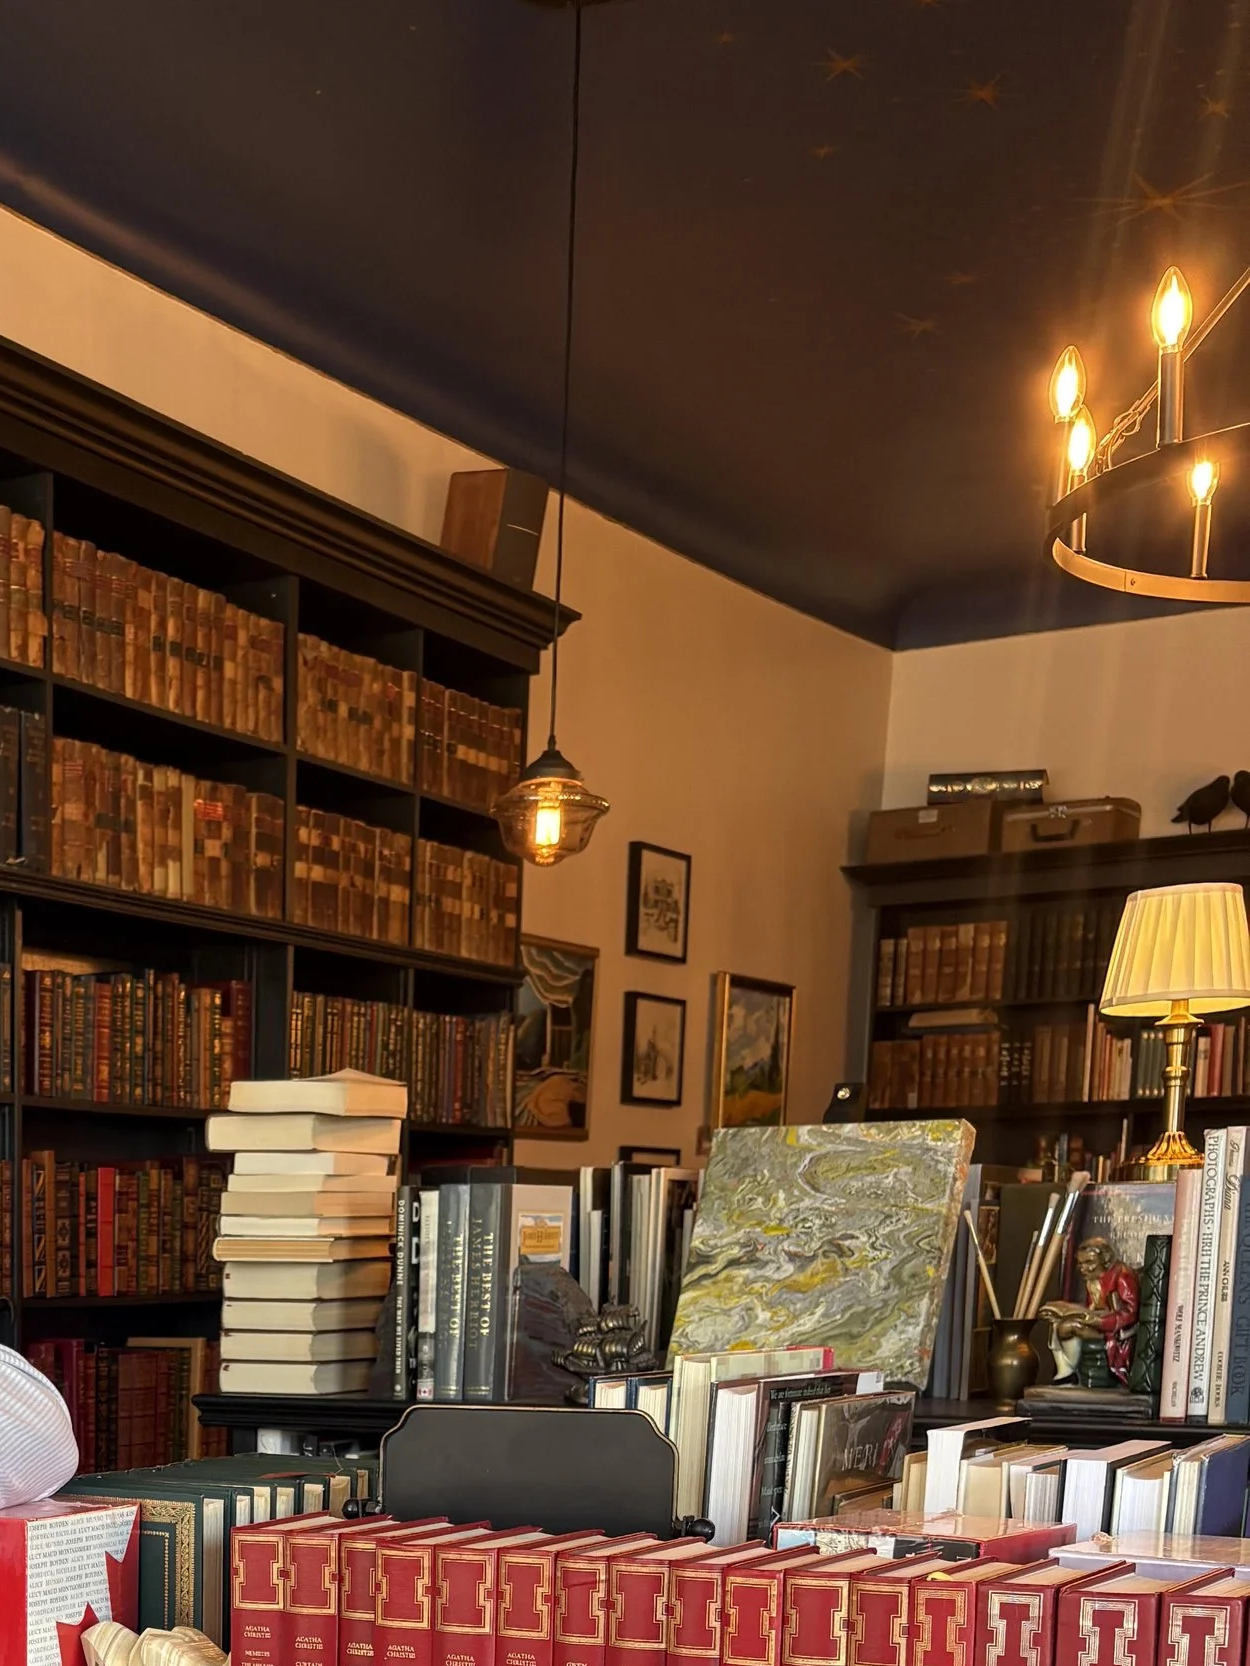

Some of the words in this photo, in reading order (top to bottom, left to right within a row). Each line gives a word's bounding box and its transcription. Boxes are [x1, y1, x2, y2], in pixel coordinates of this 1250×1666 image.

[1204, 1134, 1220, 1225] PHOTOGRAPHS
[396, 1200, 405, 1248] DOMINICK
[1201, 1232, 1212, 1257] HRH
[396, 1252, 404, 1285] DUNNE
[1199, 1258, 1211, 1282] THE
[1197, 1283, 1209, 1327] PRINCE
[1193, 1328, 1205, 1382] ANDREW
